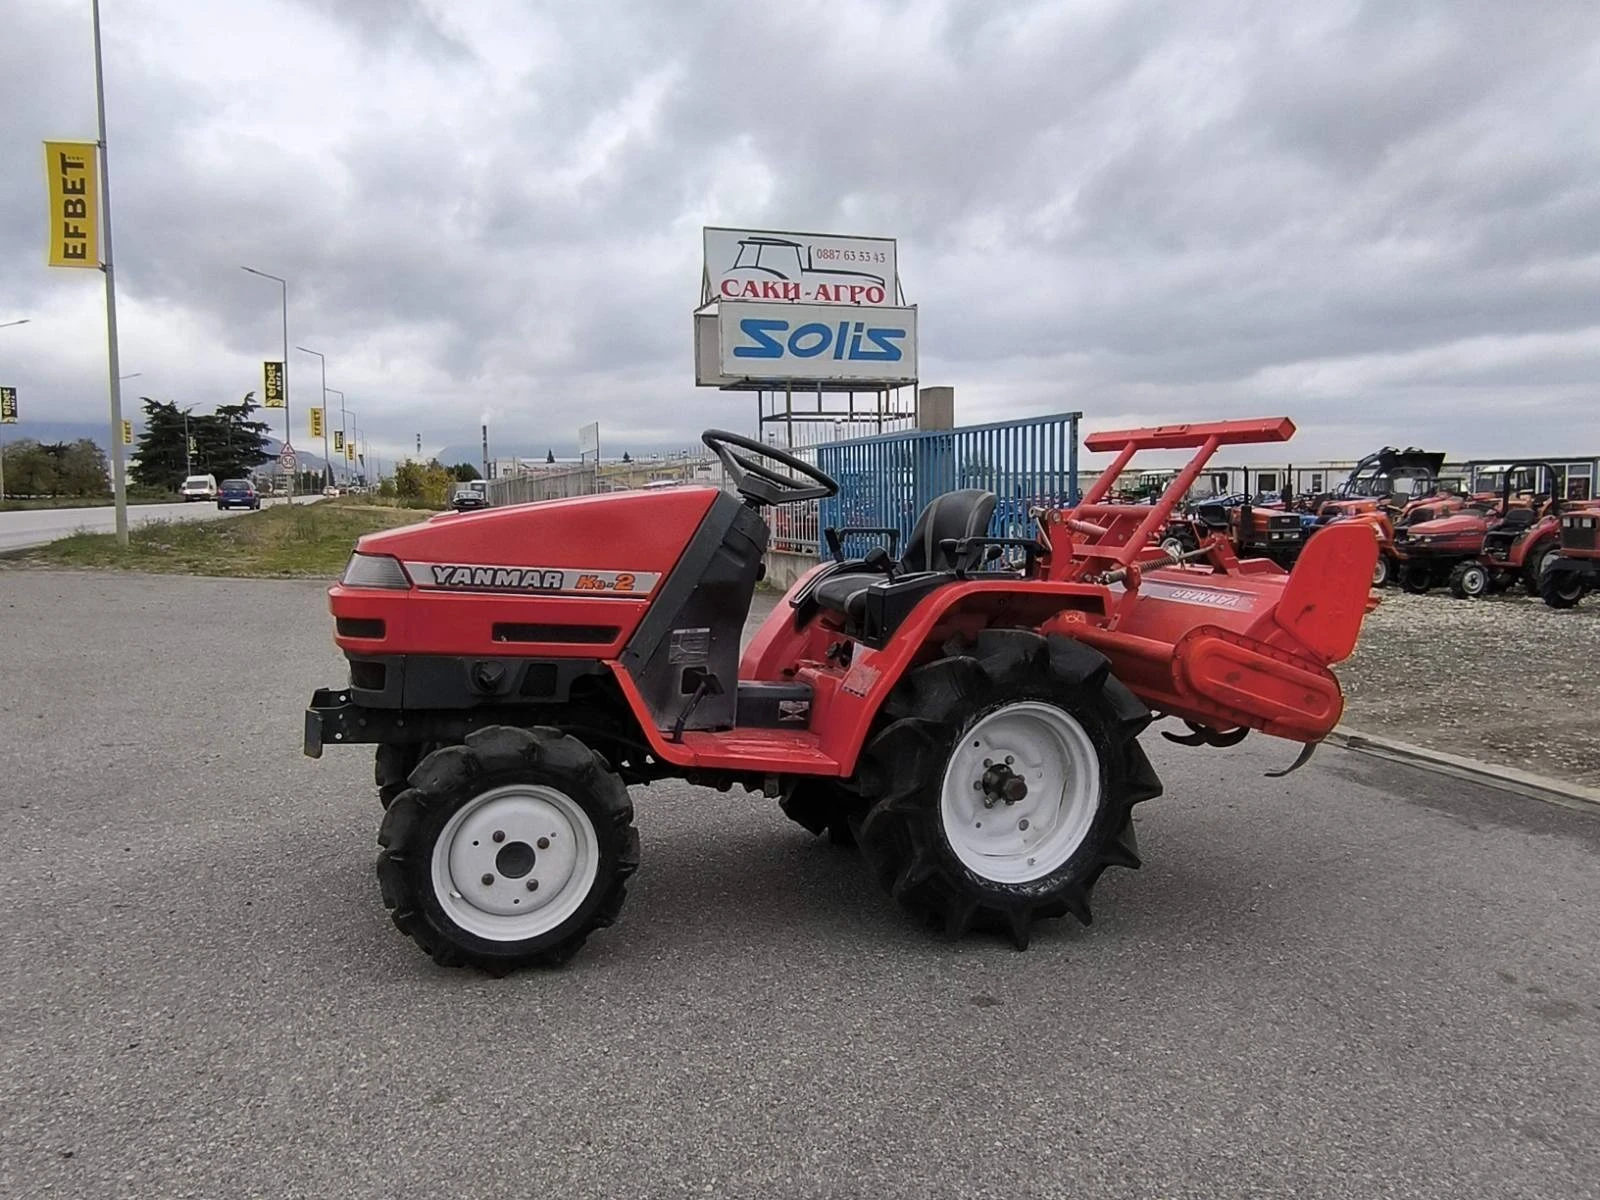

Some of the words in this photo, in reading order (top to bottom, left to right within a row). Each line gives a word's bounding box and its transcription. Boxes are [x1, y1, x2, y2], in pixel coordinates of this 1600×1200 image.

[60, 152, 87, 260] EFBET
[816, 248, 841, 260] 0887
[844, 250, 856, 261] 63
[282, 457, 295, 466] 50
[432, 565, 564, 589] YANMAR
[1171, 588, 1240, 607] YANMAR
